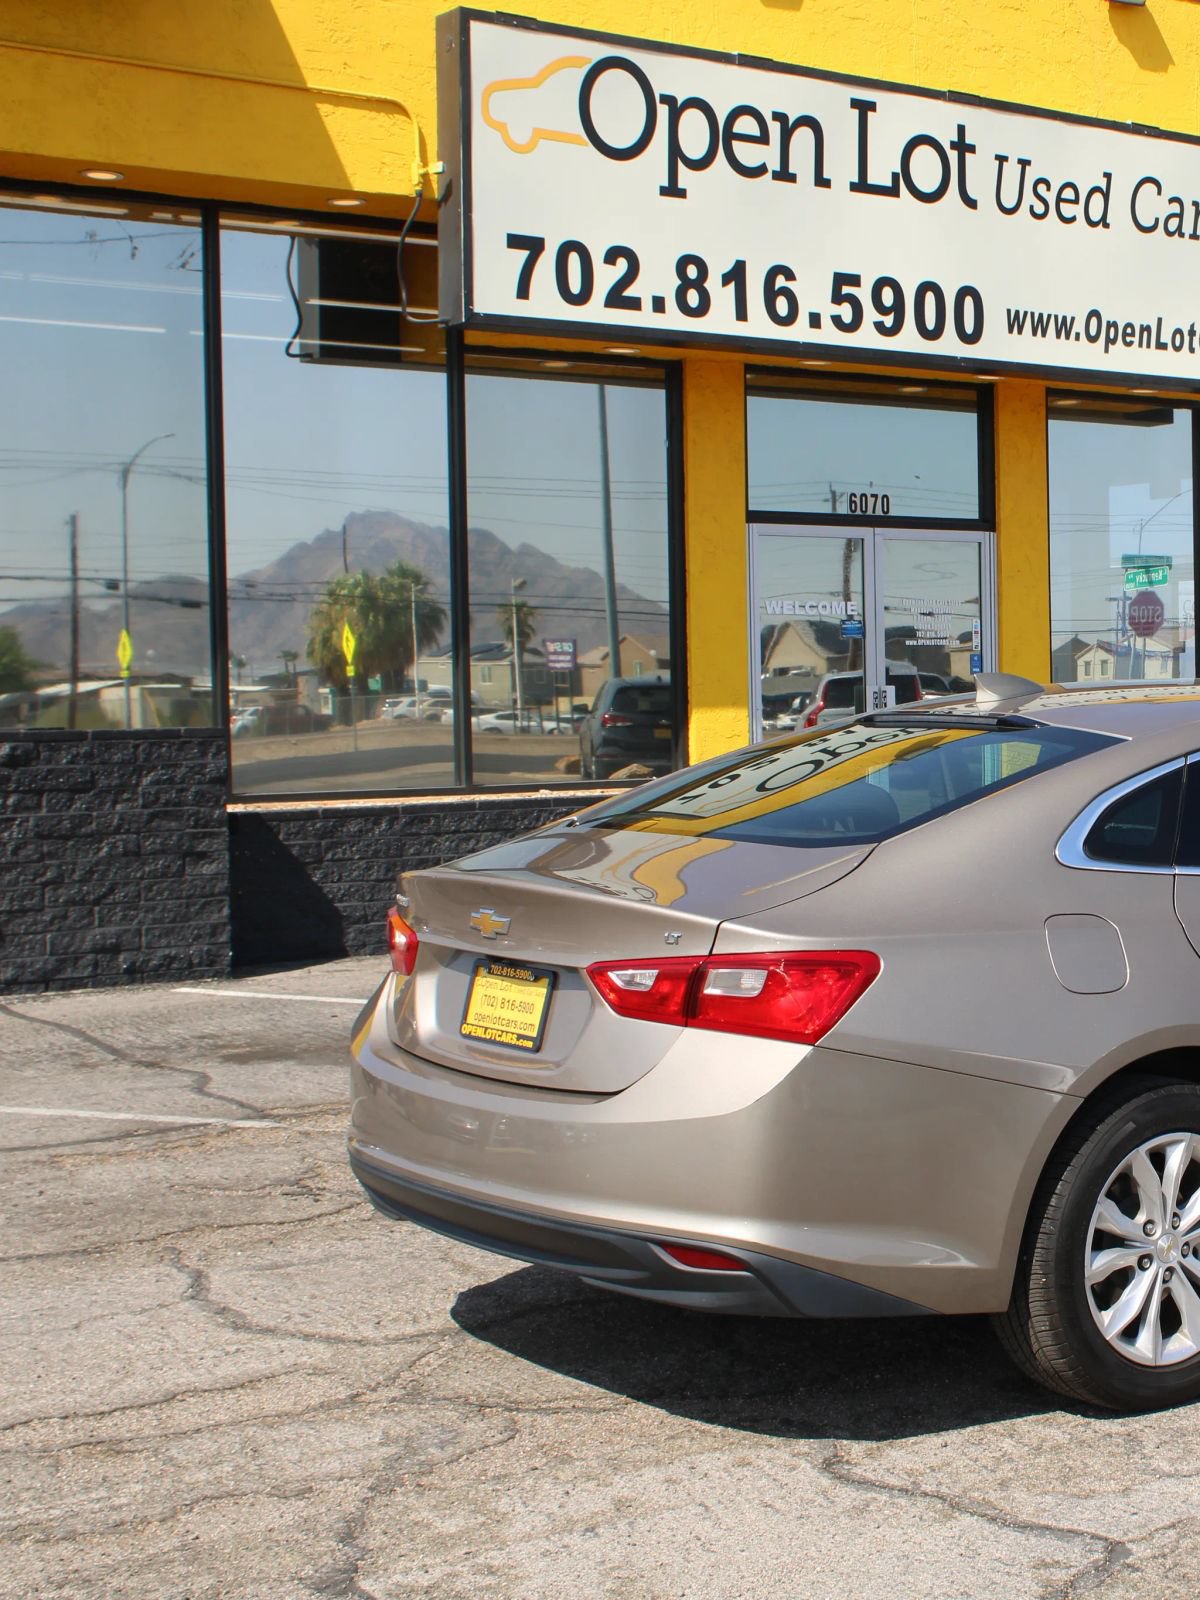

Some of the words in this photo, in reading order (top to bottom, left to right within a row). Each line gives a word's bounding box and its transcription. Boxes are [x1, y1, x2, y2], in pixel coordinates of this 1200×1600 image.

[578, 55, 831, 199] Open
[849, 97, 978, 210] Lot
[995, 154, 1113, 228] Used
[506, 234, 986, 345] 702.816.5900
[849, 492, 890, 515] 6070
[765, 600, 857, 616] WELCOME
[664, 931, 682, 945] LT
[480, 994, 498, 1011] (702)
[474, 1011, 535, 1032] openlotcars.com
[462, 1024, 533, 1048] OPENLOTCARS.com
